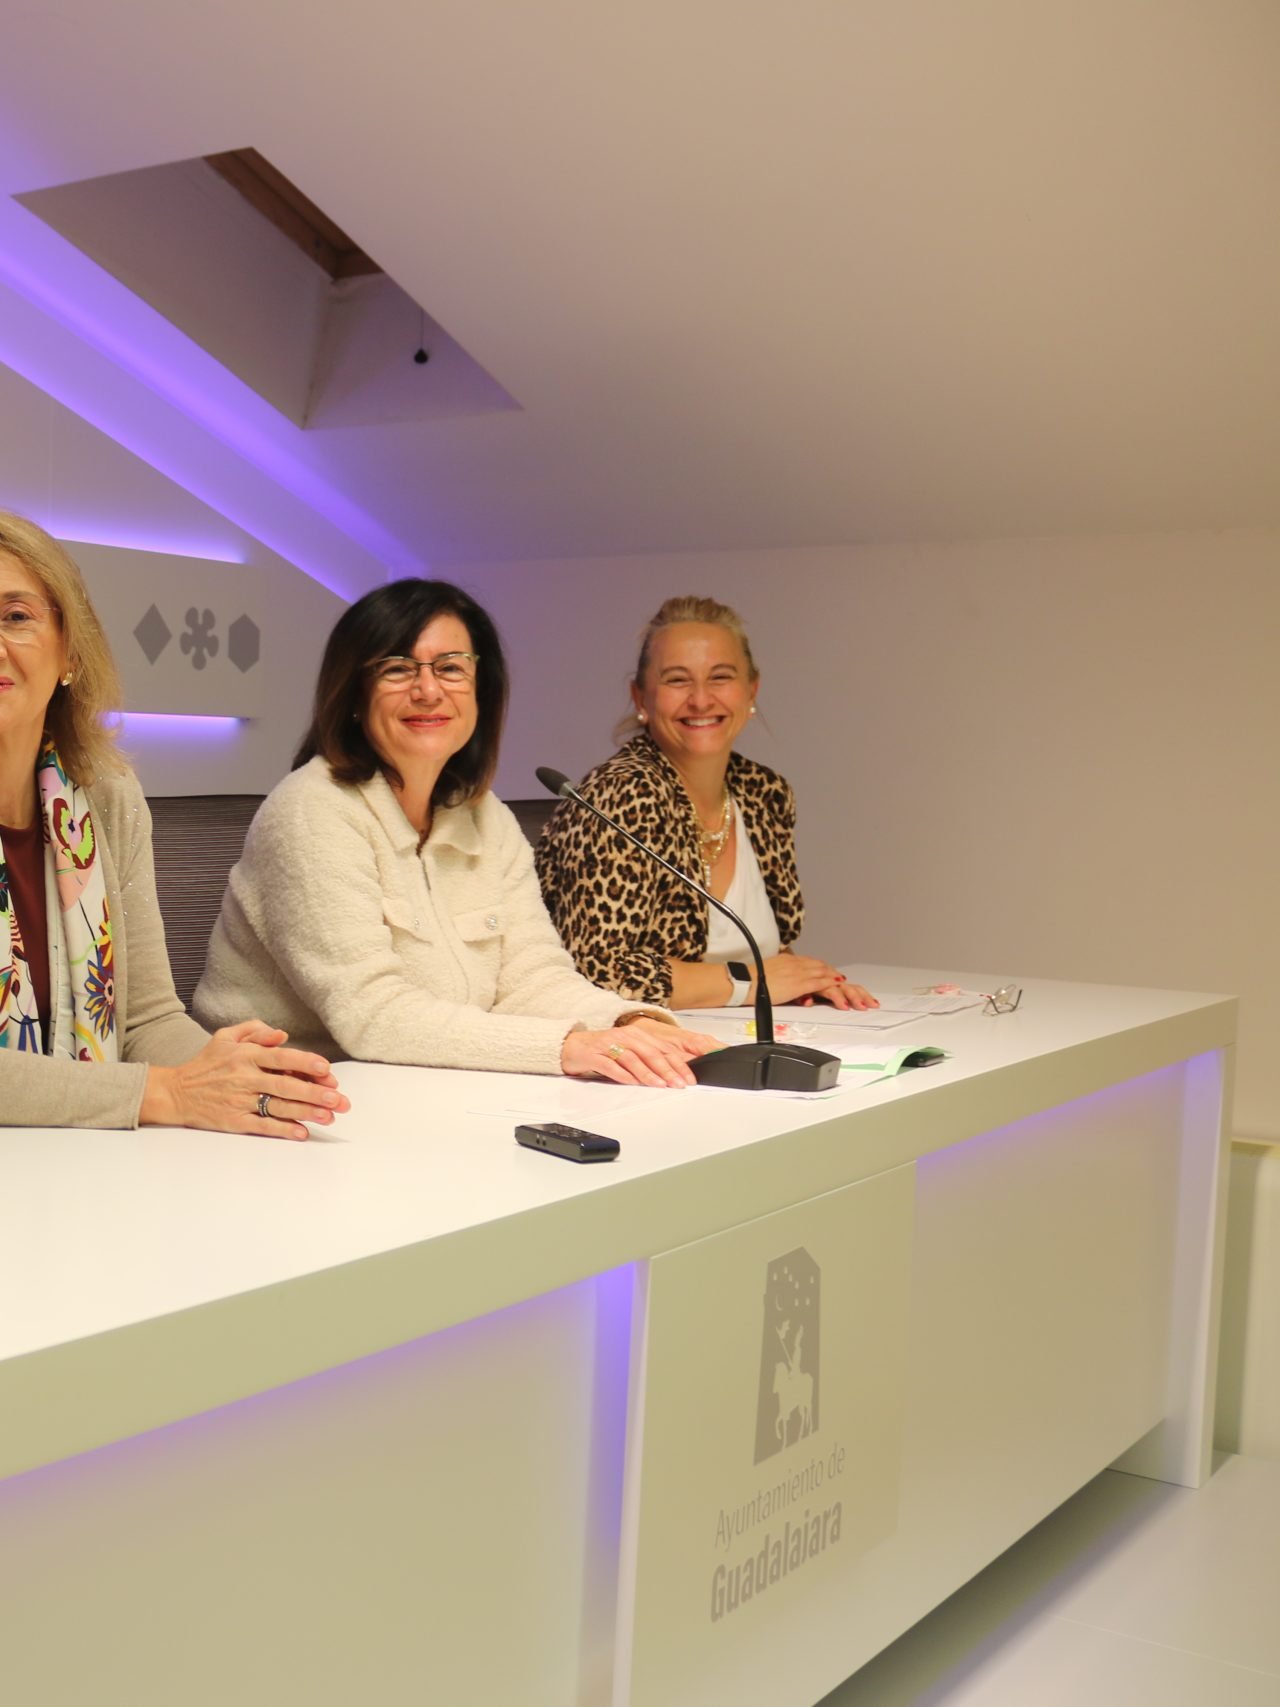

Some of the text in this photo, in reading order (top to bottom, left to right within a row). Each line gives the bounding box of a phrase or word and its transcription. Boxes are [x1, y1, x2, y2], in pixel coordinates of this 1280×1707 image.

[715, 1441, 846, 1552] Ayuntamiento de
[710, 1501, 842, 1623] Guadalajara
